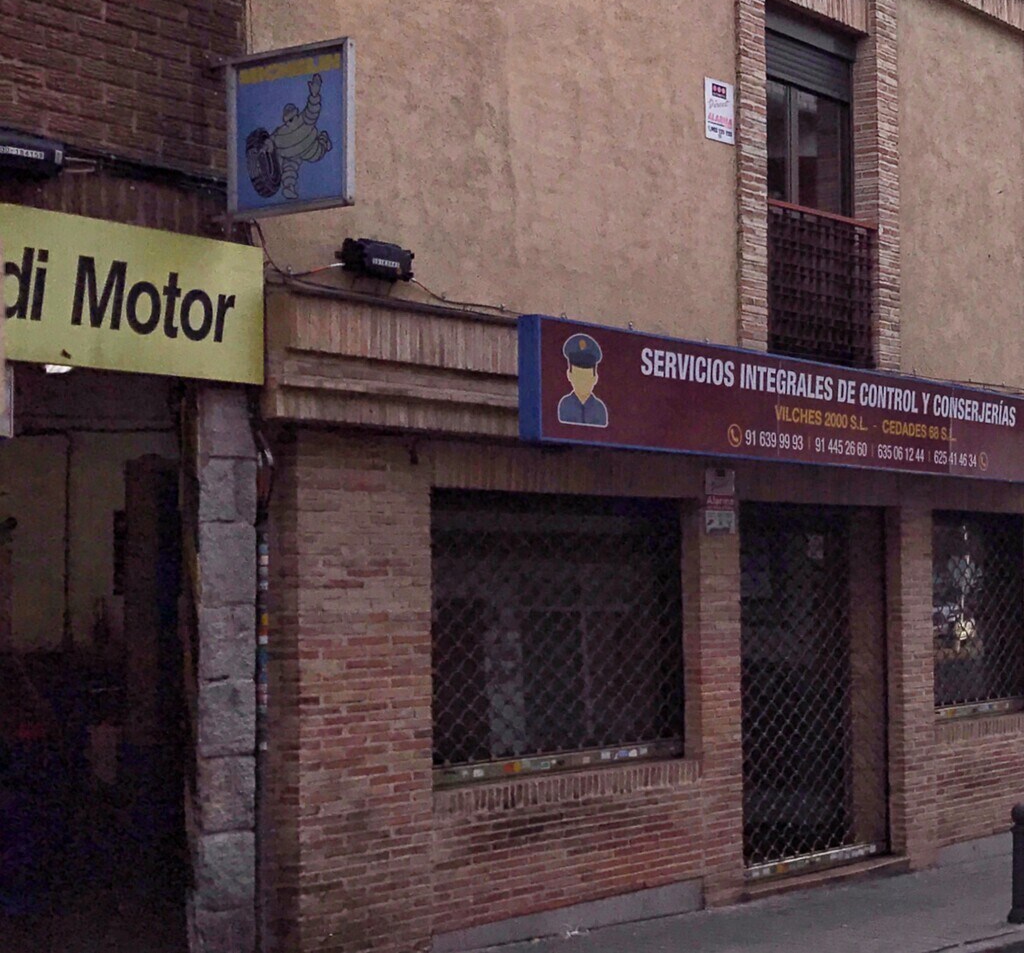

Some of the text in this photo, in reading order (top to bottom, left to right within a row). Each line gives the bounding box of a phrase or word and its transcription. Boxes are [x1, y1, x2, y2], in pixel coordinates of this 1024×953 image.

[71, 254, 236, 343] Motor
[640, 347, 1016, 427] SERVICIOS INTEGRALES DE CONTROL Y CONSERJERÍAS
[745, 429, 756, 446] 91
[759, 431, 777, 448] 639
[779, 433, 791, 449] 99
[792, 435, 803, 451] 93
[815, 437, 825, 452] 91
[828, 437, 844, 455] 445
[905, 447, 914, 462] 12
[915, 448, 925, 462] 44
[775, 405, 823, 426] VILCHES
[824, 412, 849, 429] 2000
[882, 419, 927, 438] CEDADES
